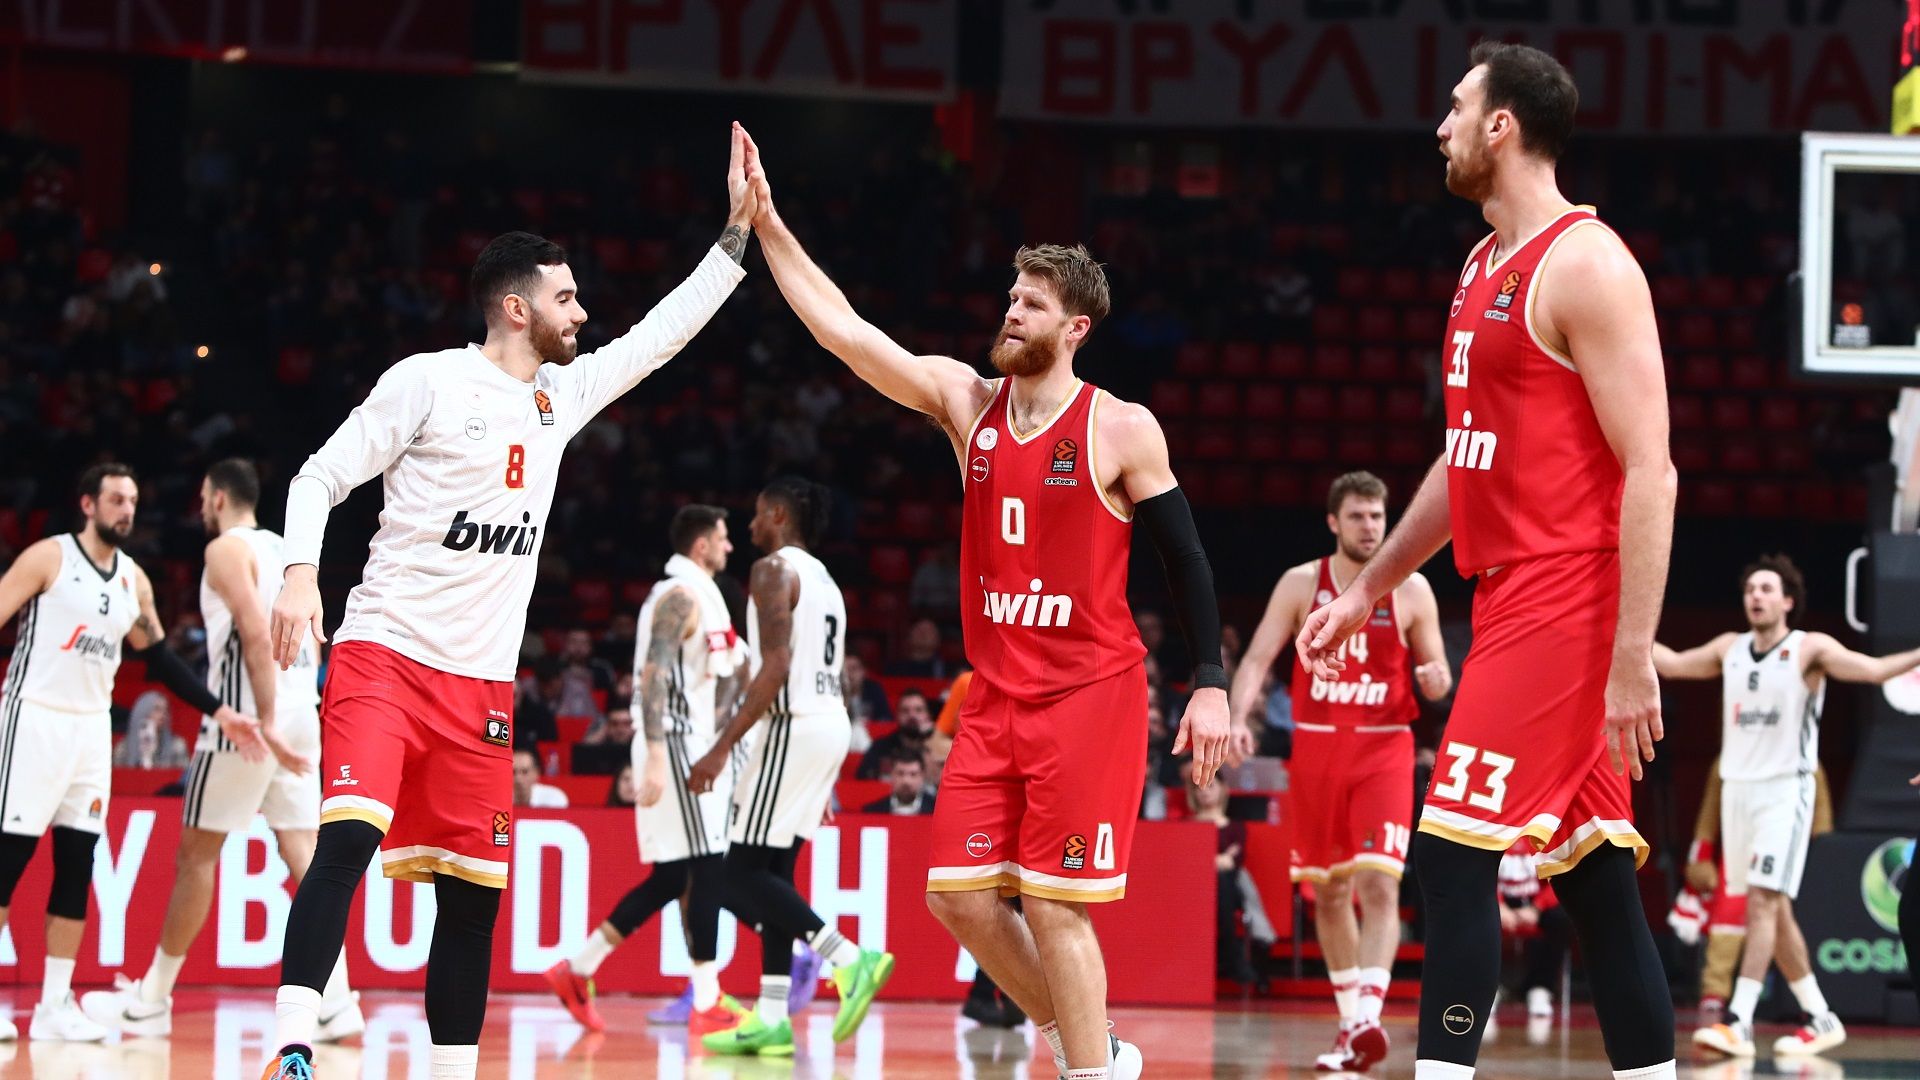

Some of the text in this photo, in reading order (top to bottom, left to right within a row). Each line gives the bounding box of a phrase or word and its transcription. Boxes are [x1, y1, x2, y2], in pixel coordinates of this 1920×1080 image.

[505, 445, 525, 489] 8
[442, 511, 537, 556] bwin
[1002, 497, 1025, 544] 0
[99, 592, 110, 615] 3
[1311, 673, 1388, 705] bwin
[1748, 671, 1760, 691] 6
[1433, 741, 1516, 814] 33
[1093, 823, 1115, 869] 0
[1383, 821, 1410, 858] 14
[1761, 855, 1774, 875] 6
